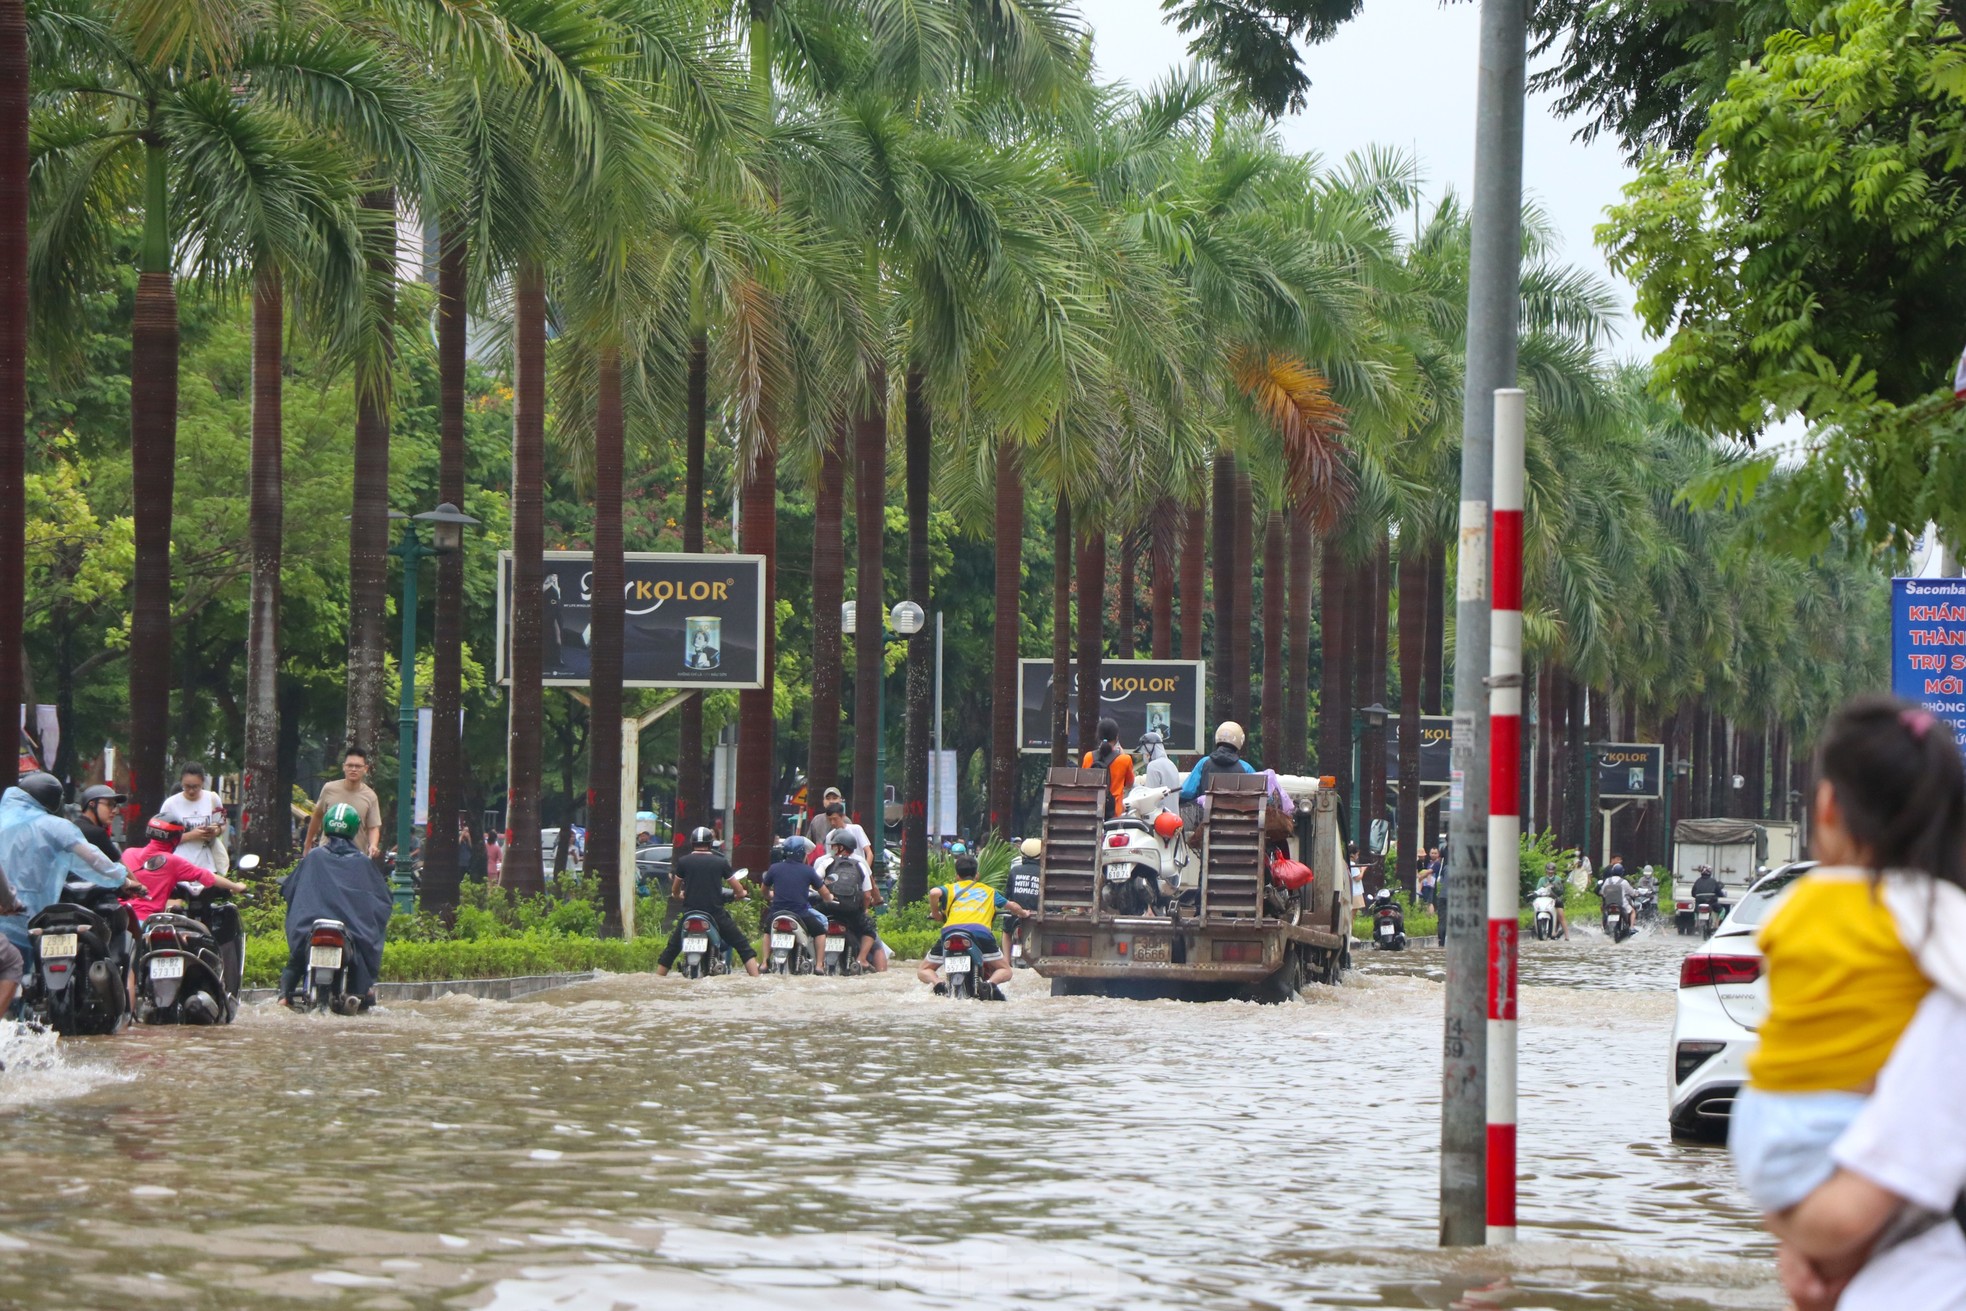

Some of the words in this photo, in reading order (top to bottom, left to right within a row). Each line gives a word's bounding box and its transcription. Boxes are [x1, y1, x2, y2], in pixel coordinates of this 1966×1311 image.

[1909, 626, 1966, 645] THÀN
[1908, 654, 1946, 673] TRỤ
[1951, 654, 1966, 670] S
[1925, 675, 1963, 694] MỚI
[328, 819, 348, 829] Grab
[1013, 886, 1039, 895] HOMIES
[1137, 949, 1165, 960] 6566
[152, 967, 181, 977] 573.11
